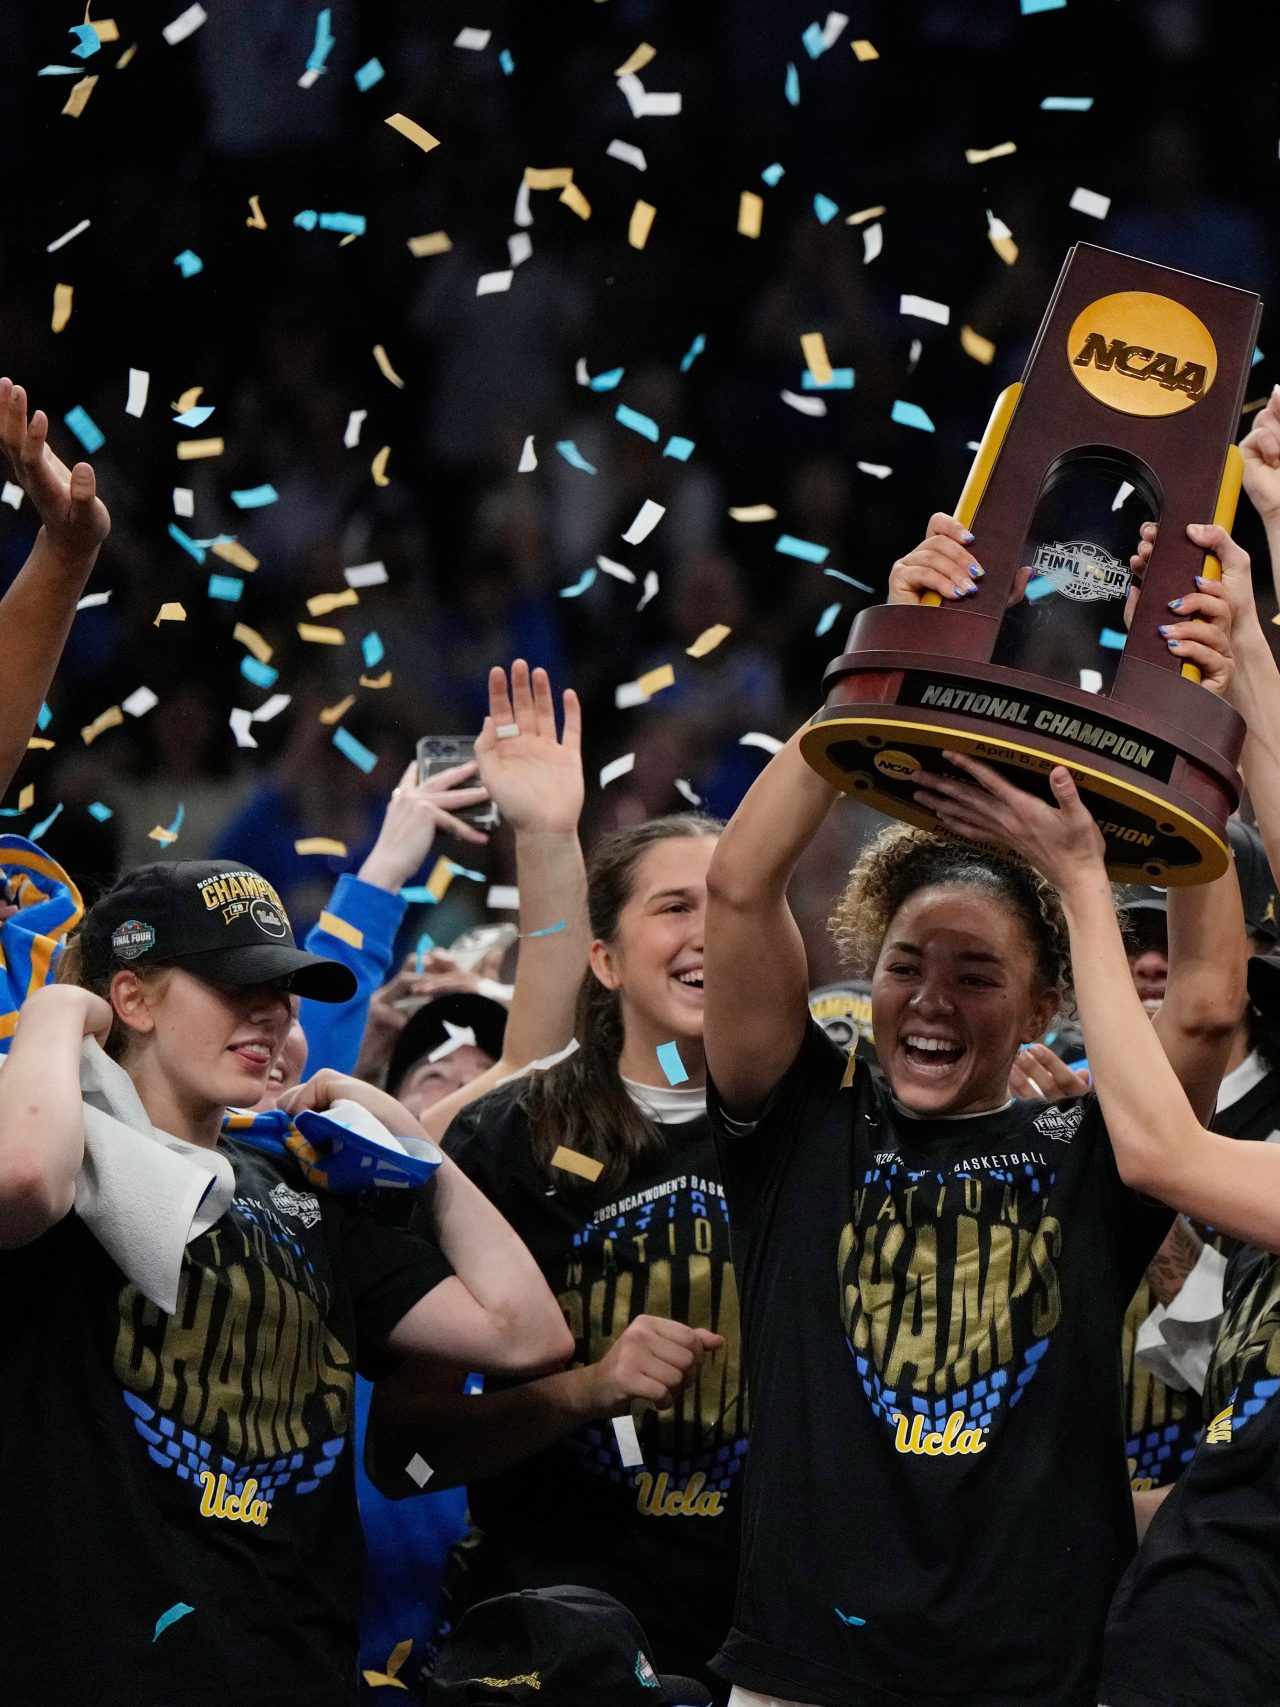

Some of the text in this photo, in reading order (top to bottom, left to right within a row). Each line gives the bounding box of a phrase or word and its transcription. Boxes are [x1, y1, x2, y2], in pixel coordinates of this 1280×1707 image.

[1073, 332, 1207, 402] NCAA
[1038, 551, 1081, 576] FINAL
[921, 685, 1155, 768] NATIONAL CHAMPION
[878, 760, 914, 775] NCA
[975, 742, 1014, 761] April
[1038, 760, 1085, 782] 26
[1098, 820, 1156, 847] PION
[196, 875, 219, 889] NCAA
[131, 931, 152, 944] FOUR
[1039, 1115, 1065, 1129] FINA
[953, 1151, 1047, 1173] BASKETBALL
[594, 1203, 617, 1224] 2026
[642, 1175, 687, 1203] WOMEN'S
[892, 1410, 989, 1456] Ucla
[199, 1470, 270, 1527] Ucla
[634, 1471, 725, 1517] Ucla
